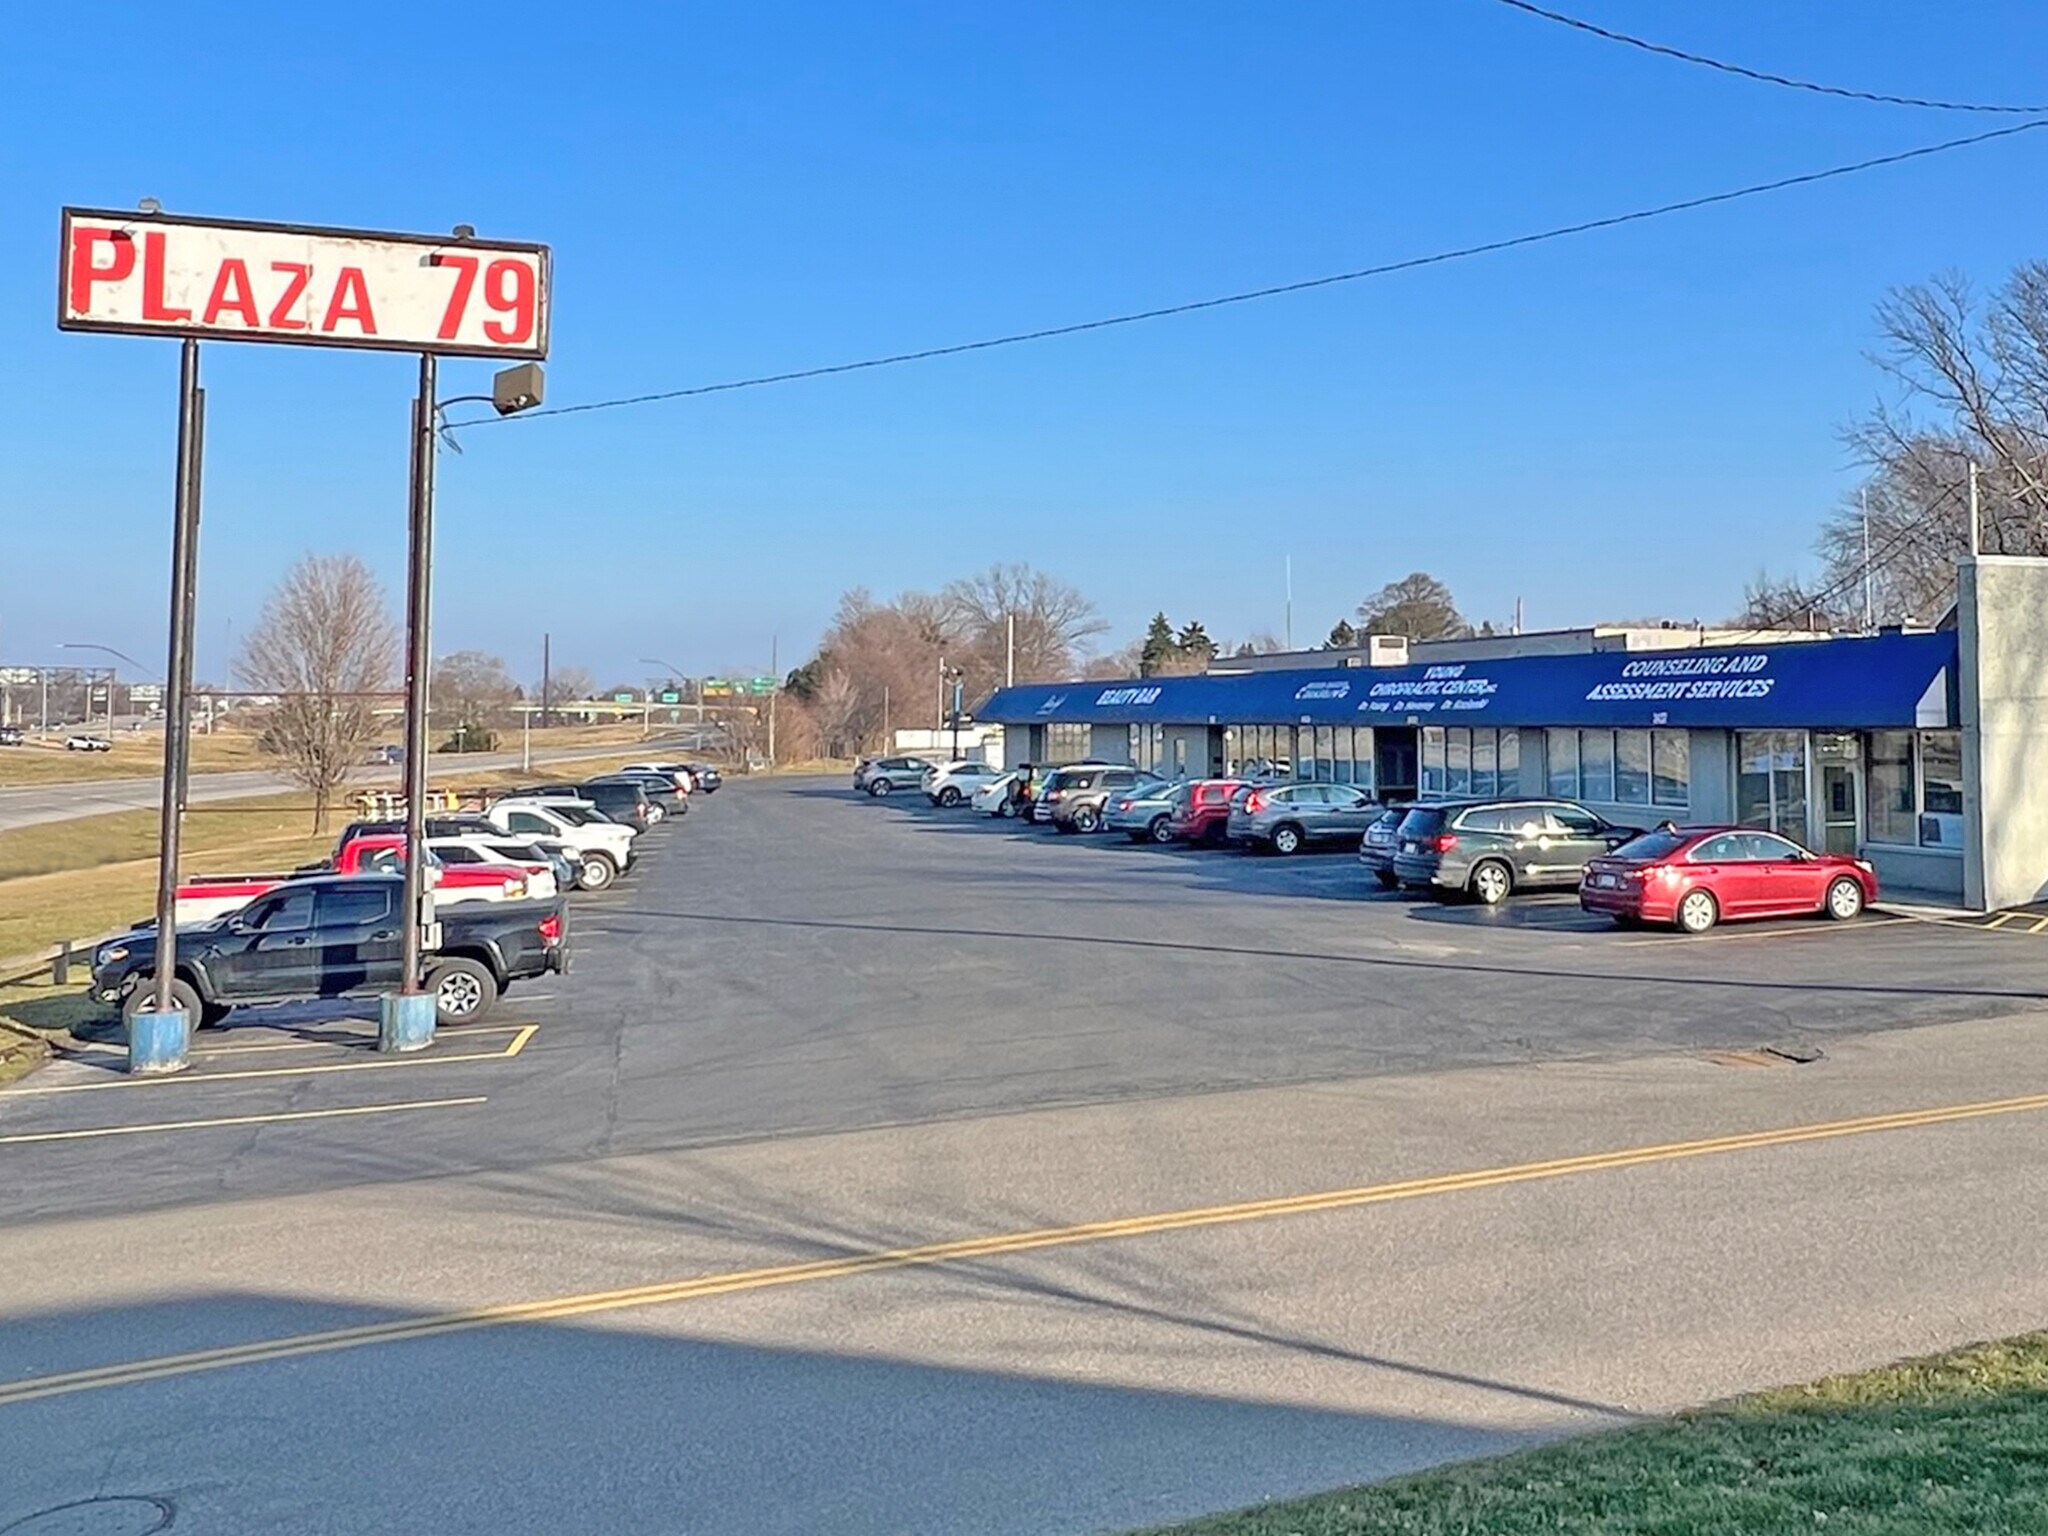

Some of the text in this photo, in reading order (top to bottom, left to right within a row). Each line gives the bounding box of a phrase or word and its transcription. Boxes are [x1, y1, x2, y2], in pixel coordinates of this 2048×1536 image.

[70, 226, 535, 344] PLAZA 79
[1622, 655, 1768, 678] COUNSELING AND
[1441, 679, 1489, 696] CENTER
[1586, 679, 1775, 700] ASSESSMENT SERVICES
